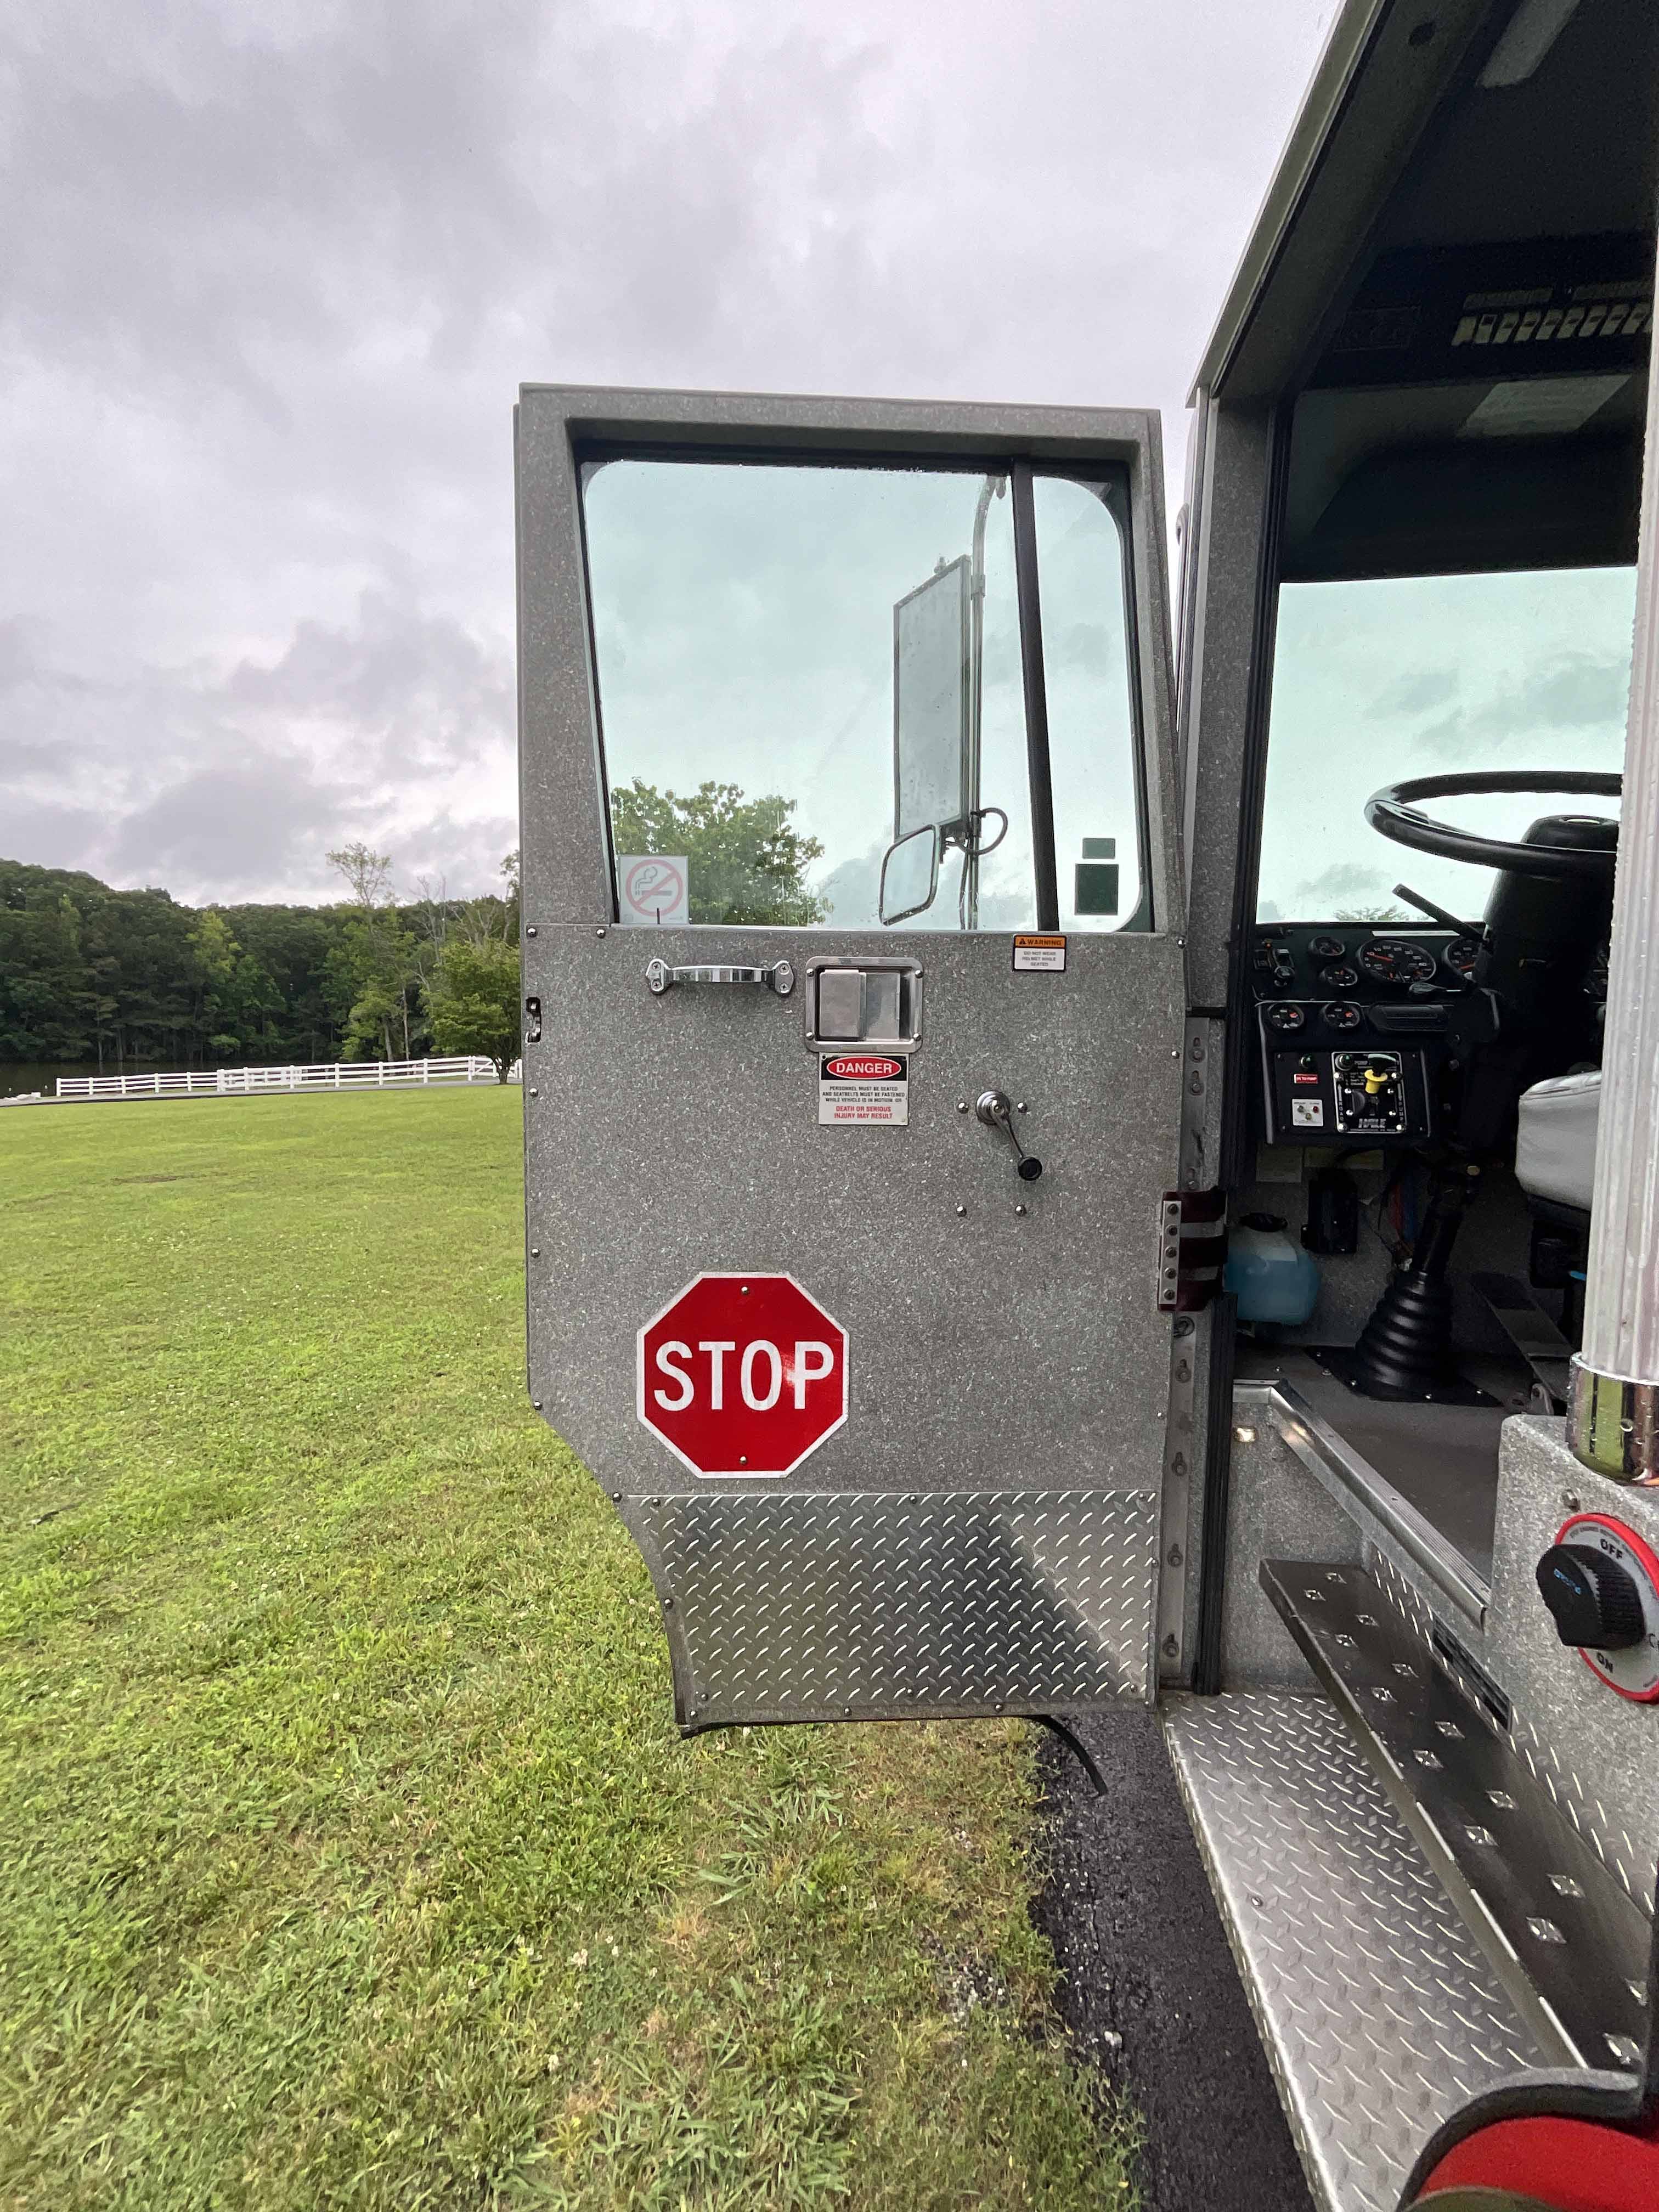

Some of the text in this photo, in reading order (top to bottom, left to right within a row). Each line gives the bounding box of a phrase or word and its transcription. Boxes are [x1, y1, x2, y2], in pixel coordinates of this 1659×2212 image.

[836, 1063, 893, 1074] DANGER
[653, 1340, 834, 1412] STOP
[1600, 1538, 1623, 1559] OFF
[1596, 1652, 1613, 1674] ON
